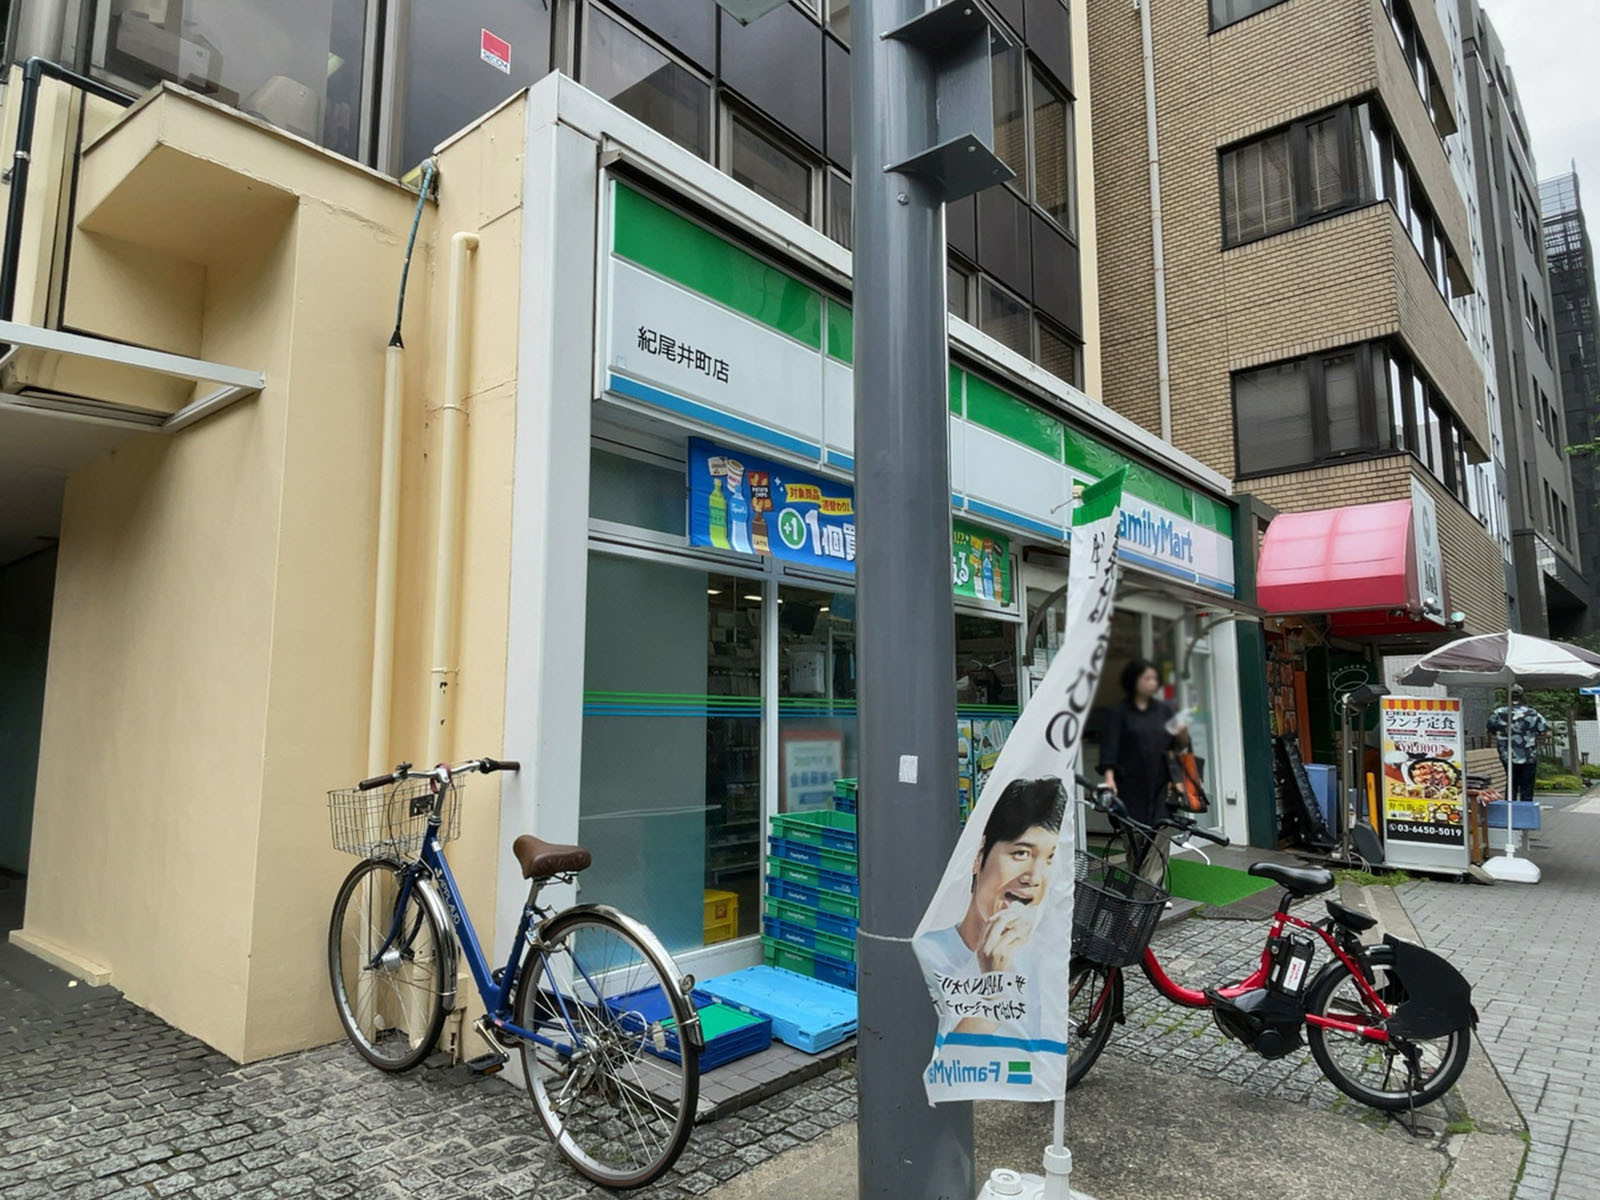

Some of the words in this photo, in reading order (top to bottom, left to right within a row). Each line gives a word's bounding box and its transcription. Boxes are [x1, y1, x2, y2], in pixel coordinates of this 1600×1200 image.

[637, 325, 730, 384] 紀尾井町店
[1119, 508, 1193, 563] amilyMart
[1386, 716, 1456, 730] ランチ定食
[1397, 824, 1462, 837] 03-6450-5019
